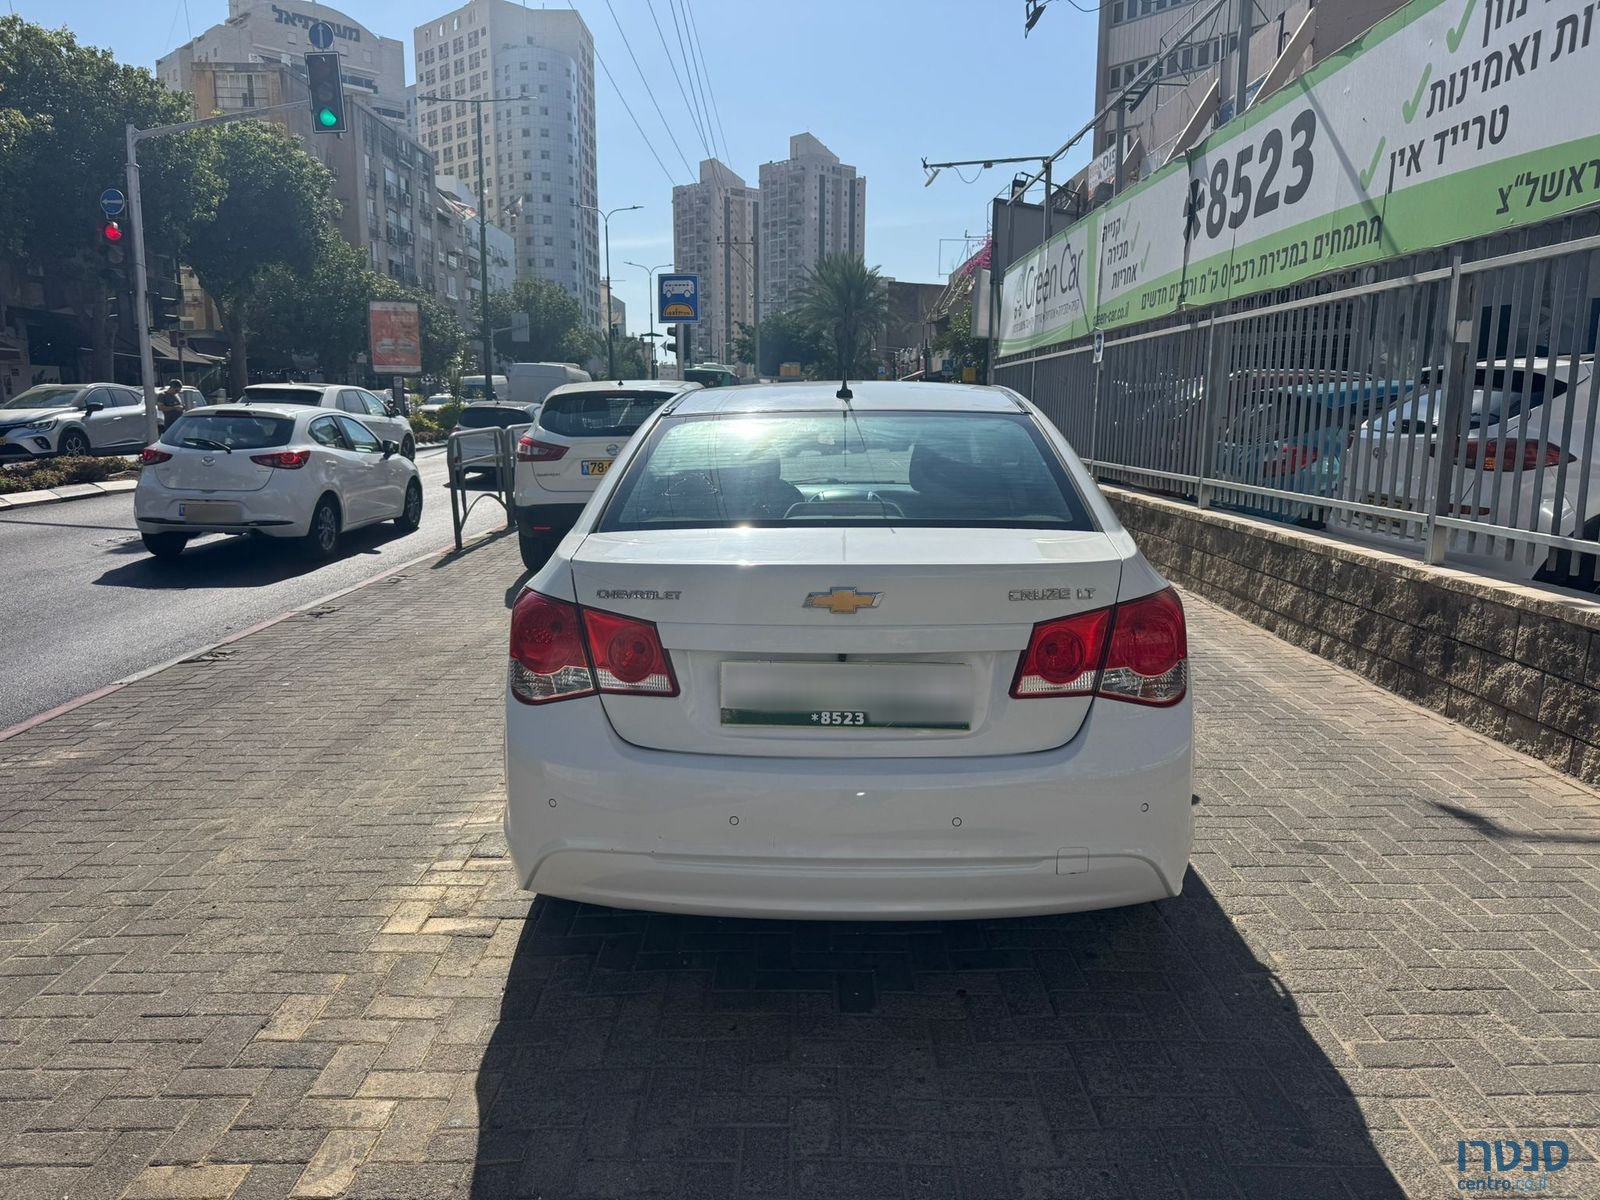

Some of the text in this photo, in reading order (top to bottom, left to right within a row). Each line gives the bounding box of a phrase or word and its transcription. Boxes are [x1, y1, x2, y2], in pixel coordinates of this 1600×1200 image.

[1426, 2, 1600, 118] ות ואמינות
[1388, 104, 1509, 194] טרייד אין
[1107, 240, 1129, 266] מכירה
[1313, 215, 1382, 260] מתמחים
[1257, 240, 1308, 277] במכירת
[1025, 243, 1084, 309] Green Car
[1111, 263, 1138, 290] אחריות
[1141, 286, 1168, 310] חדשים
[596, 589, 682, 600] CHEVROLET
[1008, 588, 1071, 601] CRUZE
